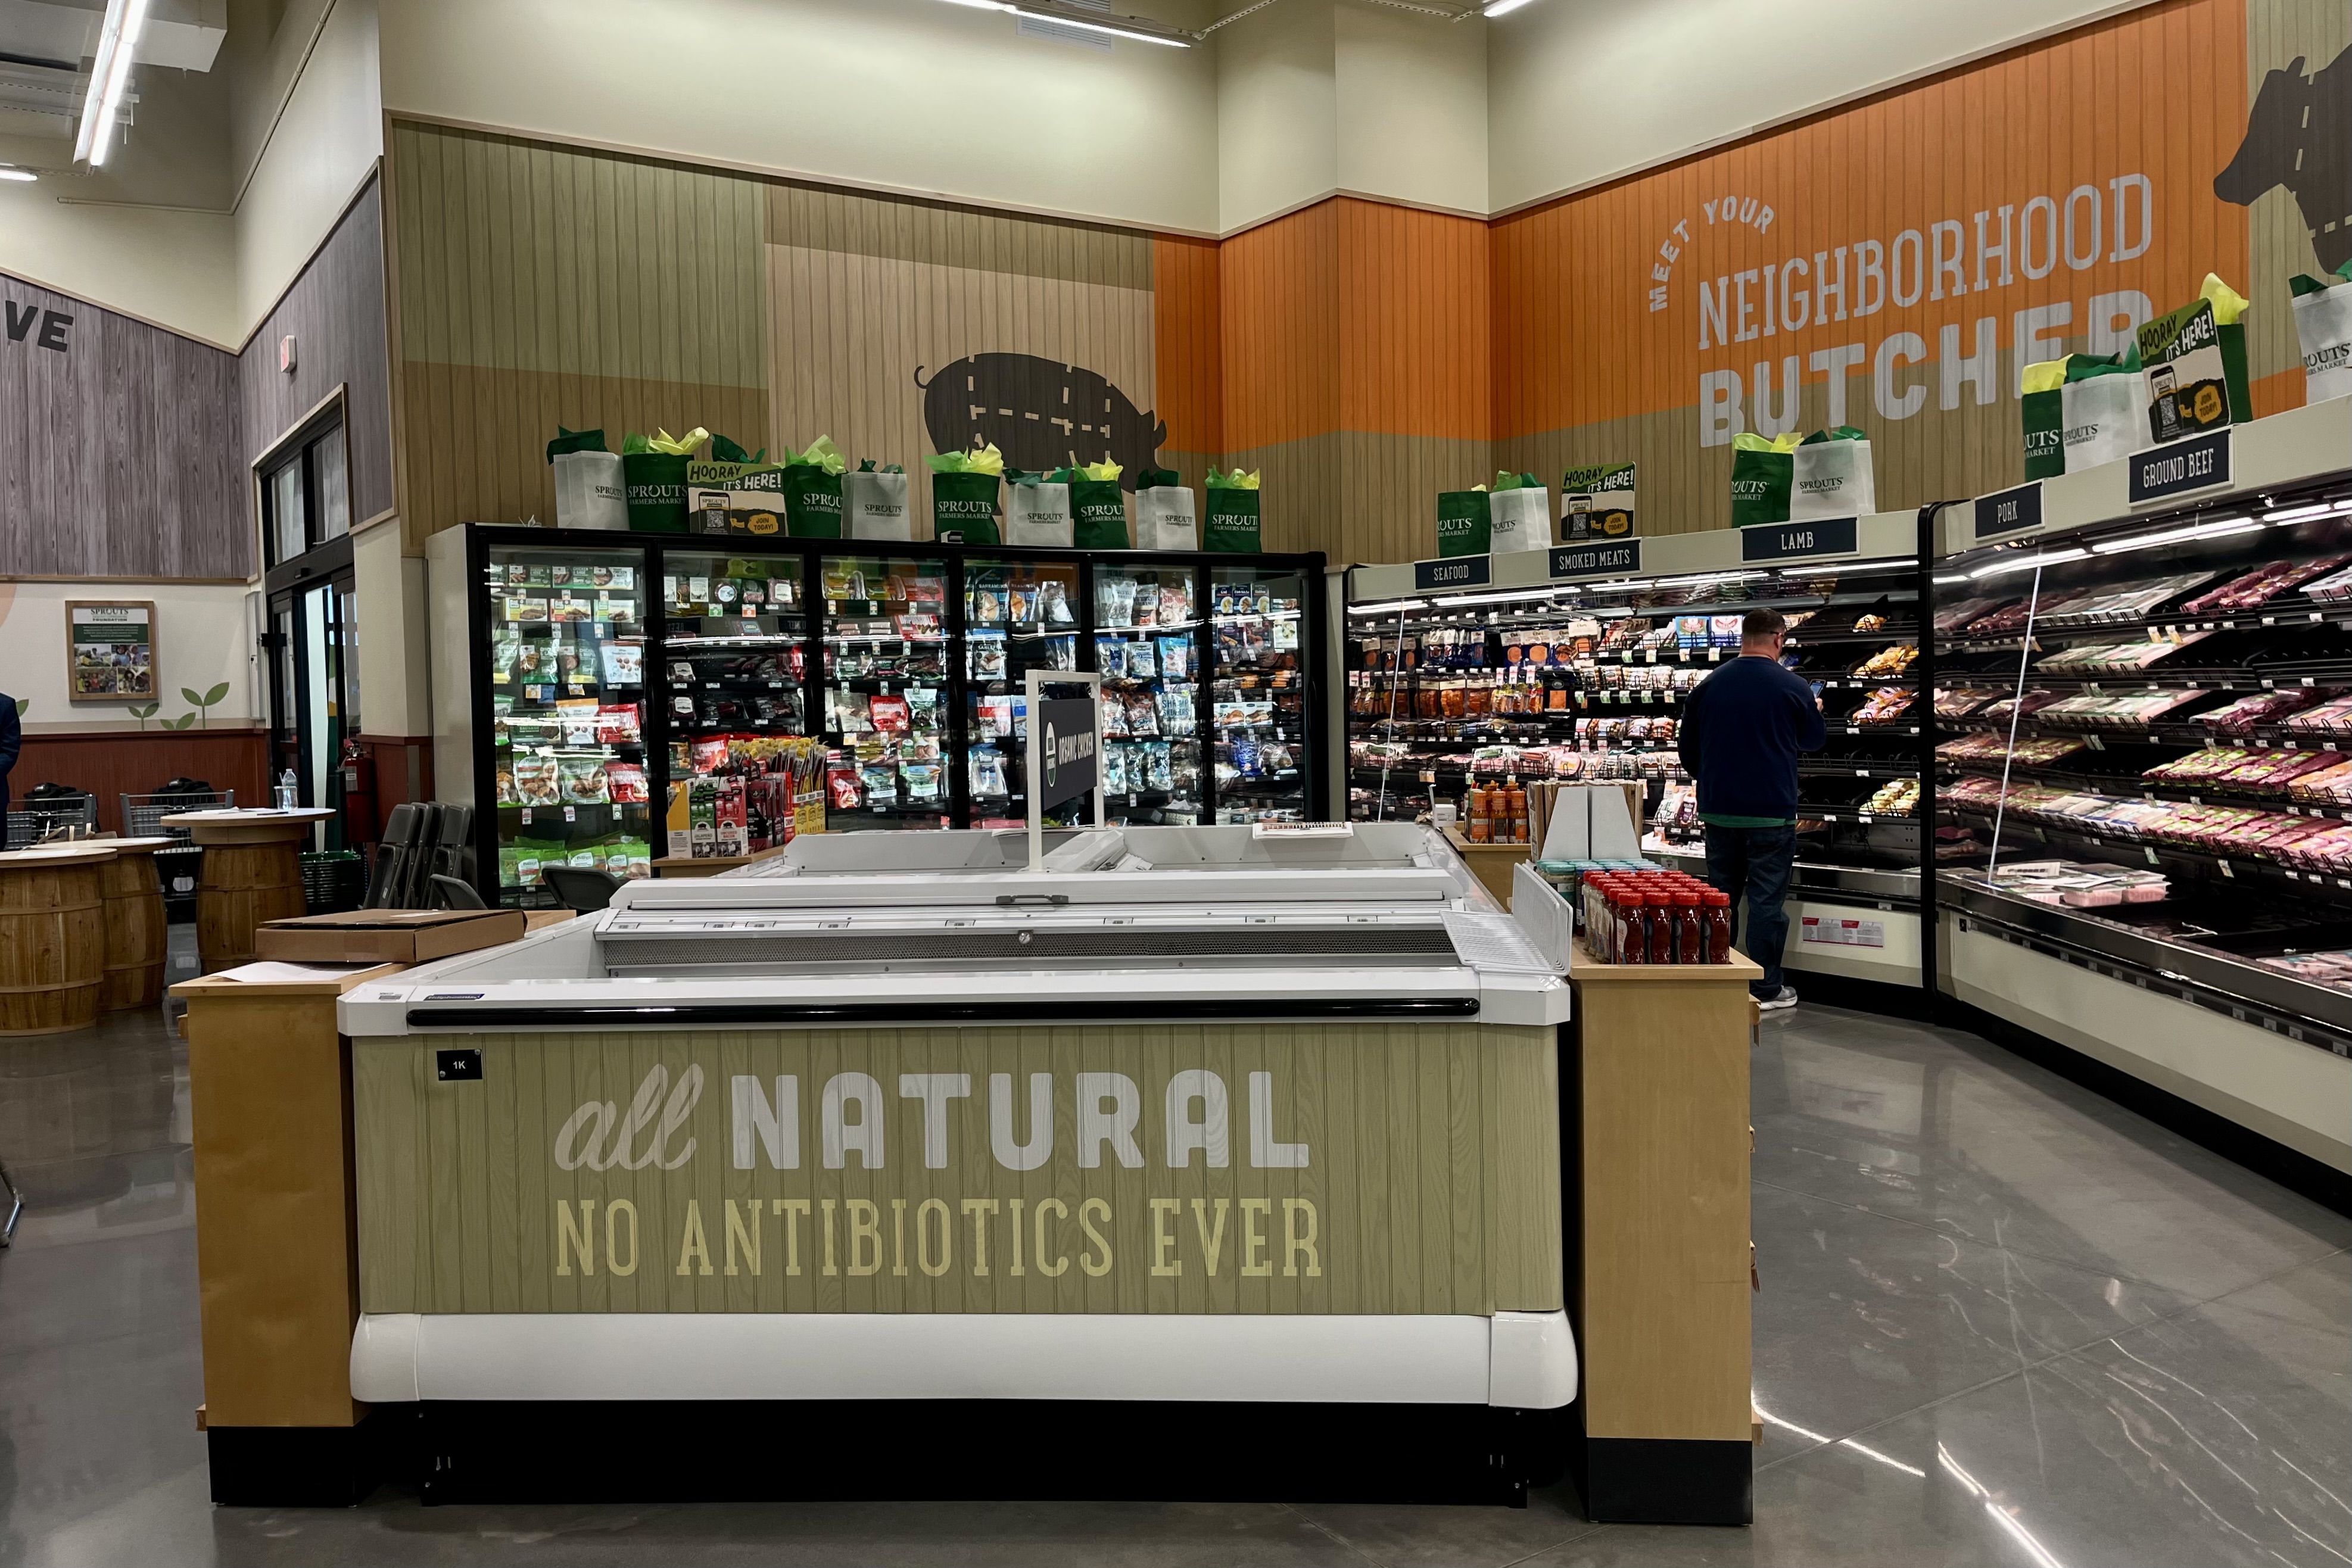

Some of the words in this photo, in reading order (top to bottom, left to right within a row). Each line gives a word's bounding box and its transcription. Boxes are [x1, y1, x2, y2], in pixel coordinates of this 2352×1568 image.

[1649, 218, 1689, 313] MEET
[1703, 196, 1774, 234] YOUR
[1699, 173, 2152, 350] NEIGHBORHOOD
[5, 300, 74, 353] VE
[2140, 314, 2177, 357] HOORAY
[2166, 339, 2180, 361] IT'S
[2182, 310, 2214, 351] HERE!
[690, 465, 742, 480] HOORAY
[1563, 466, 1603, 487] HOORAY
[2144, 455, 2185, 488] GROUND
[2188, 448, 2214, 478] BEEF
[596, 485, 622, 497] SPROUTS
[628, 485, 687, 497] SPROUTS
[723, 480, 740, 491] IT'S
[744, 473, 781, 490] HERE!
[1588, 481, 1601, 493] IT'S
[1604, 469, 1634, 490] HERE!
[1799, 477, 1843, 490] SPROUTS
[865, 504, 902, 513] SPROUTS
[939, 501, 991, 513] SPROUTS
[1997, 500, 2018, 524] PORK
[1781, 532, 1814, 550] LAMB
[1559, 552, 1595, 570] SMOKED
[1599, 549, 1630, 566] MEATS
[1434, 565, 1469, 581] SEAFOOD
[453, 1061, 466, 1069] 1K
[554, 1062, 705, 1173] all
[731, 1070, 1310, 1170] NATURAL
[555, 1199, 639, 1276] NO
[675, 1198, 1113, 1277] ANTIBIOTICS
[1149, 1198, 1322, 1276] EVER
